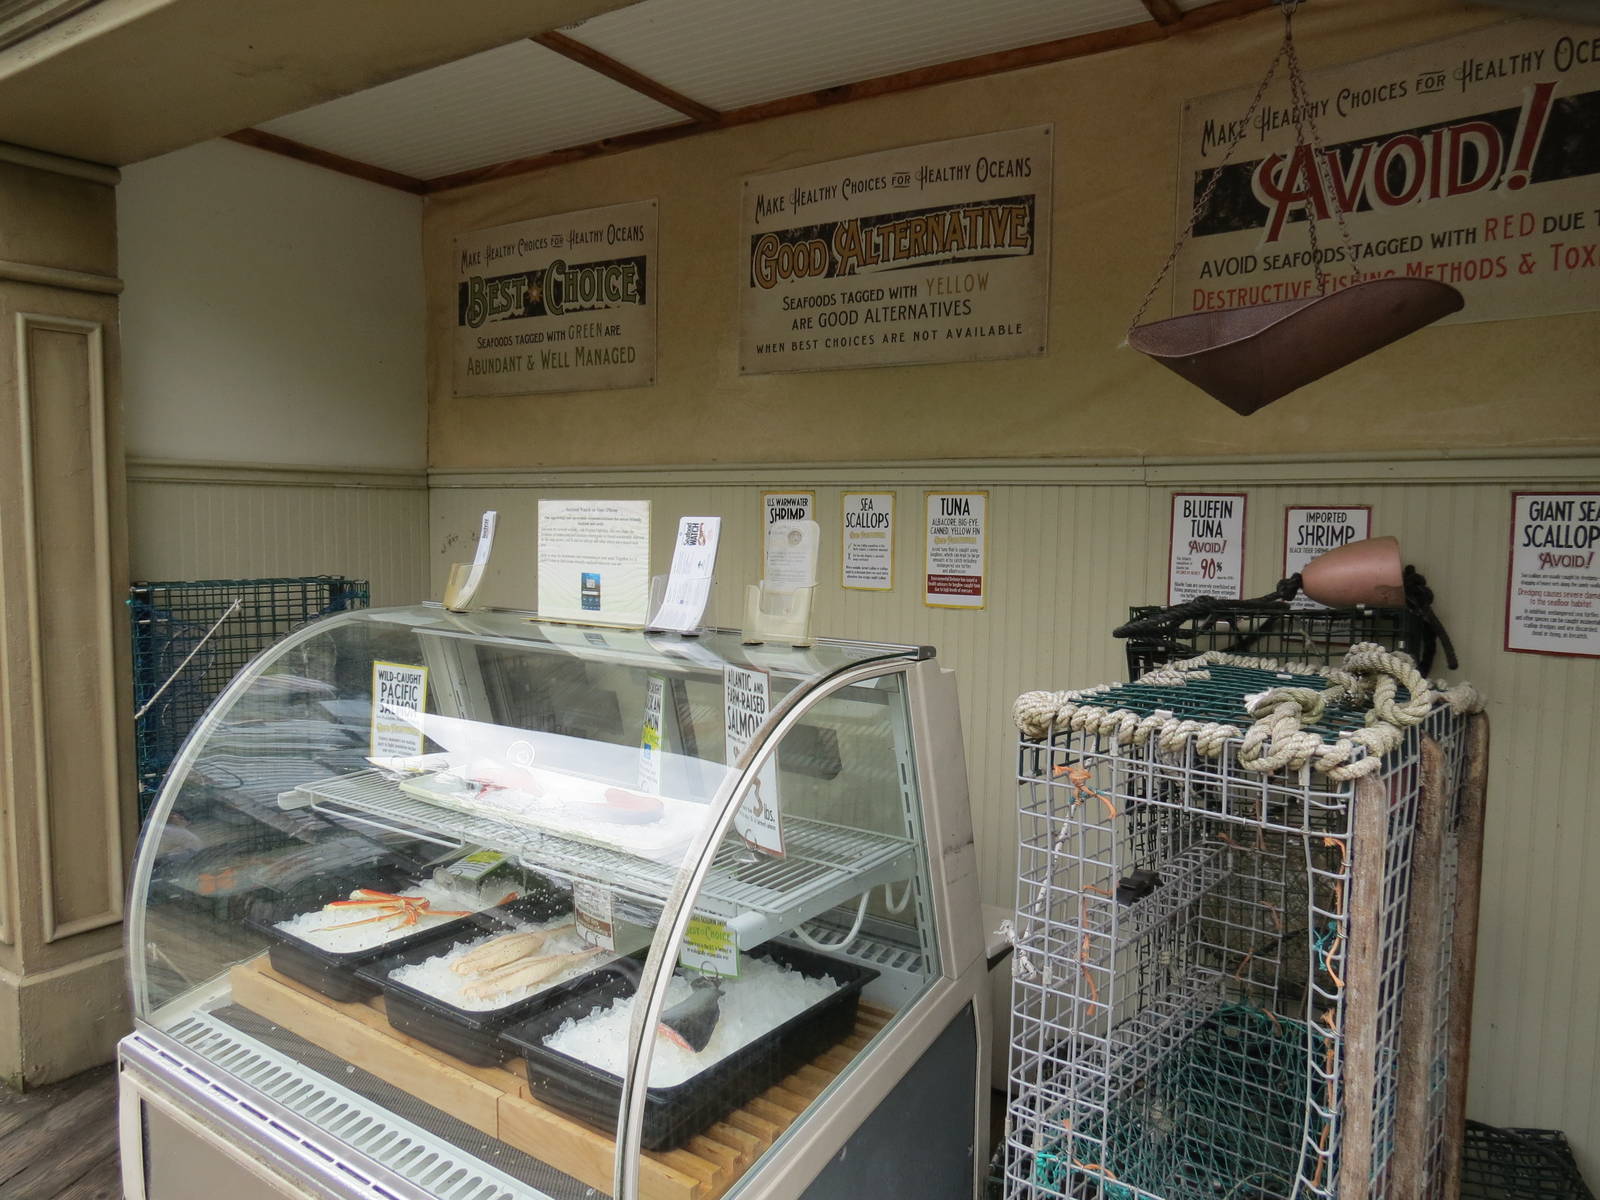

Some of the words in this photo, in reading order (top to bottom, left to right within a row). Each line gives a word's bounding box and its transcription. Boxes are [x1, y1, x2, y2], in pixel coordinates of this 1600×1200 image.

[1201, 120, 1247, 156] MAKE
[1256, 98, 1330, 141] HEALTHY
[1337, 80, 1408, 117] CHOICES
[1416, 70, 1446, 94] FOR
[1455, 49, 1545, 92] HEALTHY
[1252, 80, 1559, 243] AVOID!
[755, 194, 785, 224] MAKE
[791, 184, 837, 215] HEALTHY
[842, 178, 887, 200] CHOICES
[892, 172, 911, 188] FOR
[916, 164, 971, 190] HEALTHY
[976, 157, 1032, 183] OCEANS
[461, 251, 481, 274] MAKE
[484, 244, 515, 268] HEALTHY
[517, 238, 548, 257] CHOICES
[550, 235, 564, 248] FOR
[568, 229, 604, 250] HEALTHY
[607, 223, 644, 246] OCEANS
[753, 233, 830, 290] GOOD
[833, 204, 1030, 276] ALTERNATIVE
[1200, 256, 1257, 279] AVOID
[1263, 247, 1345, 271] SEAFOODS
[1352, 235, 1423, 259] TAGGED
[1431, 228, 1477, 248] WITH
[1484, 212, 1535, 241] RED
[1542, 211, 1584, 234] DUE
[1192, 281, 1312, 312] DESTRUCTIVE
[1405, 253, 1508, 284] METHODS
[1517, 252, 1537, 275] &
[1550, 242, 1600, 272] TOX
[466, 275, 528, 328] BEST
[544, 259, 641, 316] CHOICE
[782, 295, 837, 312] SEAFOODS
[840, 288, 885, 306] TAGGED
[888, 285, 917, 300] WITH
[926, 272, 990, 297] YELLOW
[791, 317, 813, 331] ARE
[818, 312, 859, 329] GOOD
[864, 299, 972, 325] ALTERNATIVES
[477, 333, 513, 350] SEAFOODS
[515, 332, 544, 345] TAGGED
[547, 329, 566, 342] WITH
[568, 322, 603, 340] GREEN
[605, 324, 621, 336] ARE
[756, 342, 785, 355] WHEN
[791, 339, 819, 351] BEST
[825, 334, 875, 348] CHOICES
[882, 332, 905, 344] ARE
[913, 329, 938, 341] NOT
[946, 323, 1023, 340] AVAILABLE
[467, 357, 523, 376] ABUNDANT
[527, 354, 535, 371] &
[540, 349, 570, 370] WELL
[575, 346, 636, 368] MANAGED
[776, 497, 809, 507] WARMWATER
[860, 498, 874, 511] SEA
[941, 498, 971, 516] TUNA
[1183, 500, 1233, 519] BLUEFIN
[1529, 500, 1575, 521] GIANT
[769, 508, 805, 524] SHRIMP
[845, 512, 890, 529] SCALLOPS
[1306, 512, 1347, 523] IMPORTED
[951, 527, 971, 536] YELLOW
[1191, 519, 1223, 538] TUNA
[1297, 525, 1355, 547] SHRIMP
[1523, 524, 1600, 549] SCALLOP
[1189, 540, 1227, 555] AVOID!
[1539, 552, 1595, 570] AVOID!
[378, 669, 422, 685] WILD-CAUGHT
[728, 669, 751, 692] ATLANTIC
[753, 683, 764, 695] AND
[381, 681, 418, 702] PACIFIC
[728, 687, 766, 714] FARM-RAISED
[705, 924, 731, 942] CHOICE
